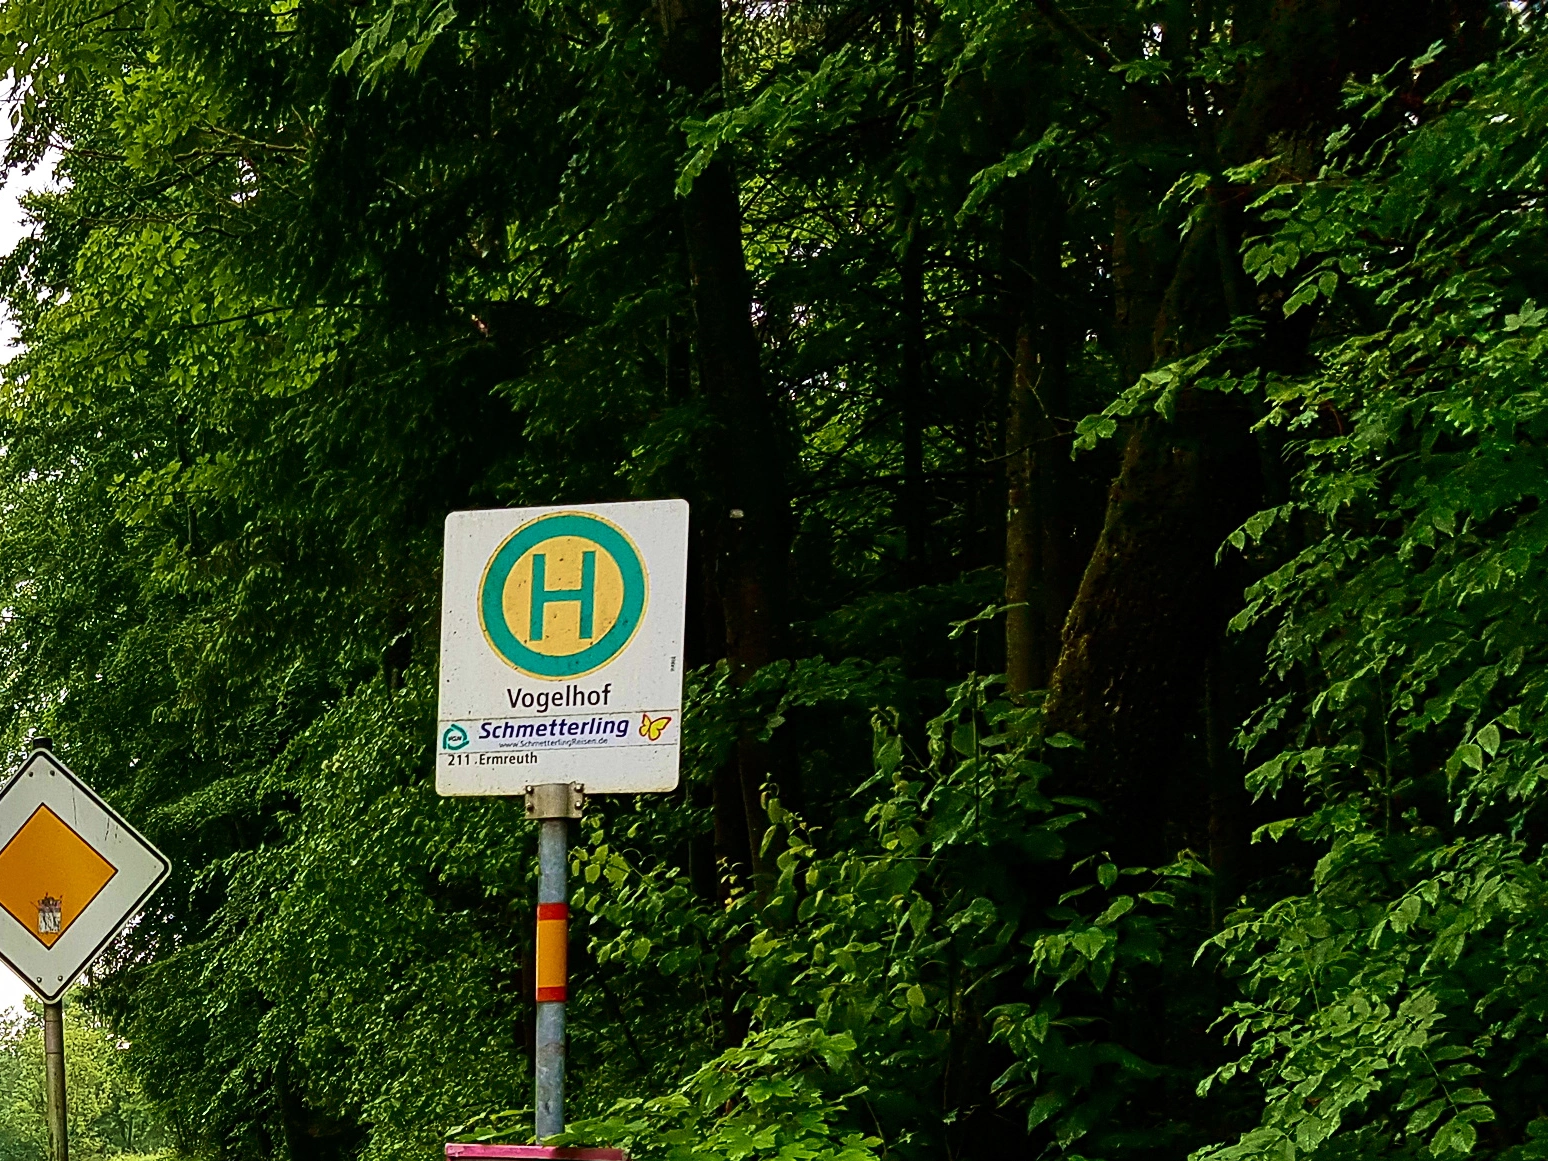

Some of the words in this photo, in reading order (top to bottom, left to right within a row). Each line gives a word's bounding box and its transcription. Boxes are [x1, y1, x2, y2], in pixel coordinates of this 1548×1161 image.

[529, 551, 596, 641] H
[507, 683, 612, 713] Vogelhof
[479, 717, 629, 739] Schmetterling
[448, 754, 470, 766] 211
[479, 752, 538, 766] Ermreuth
